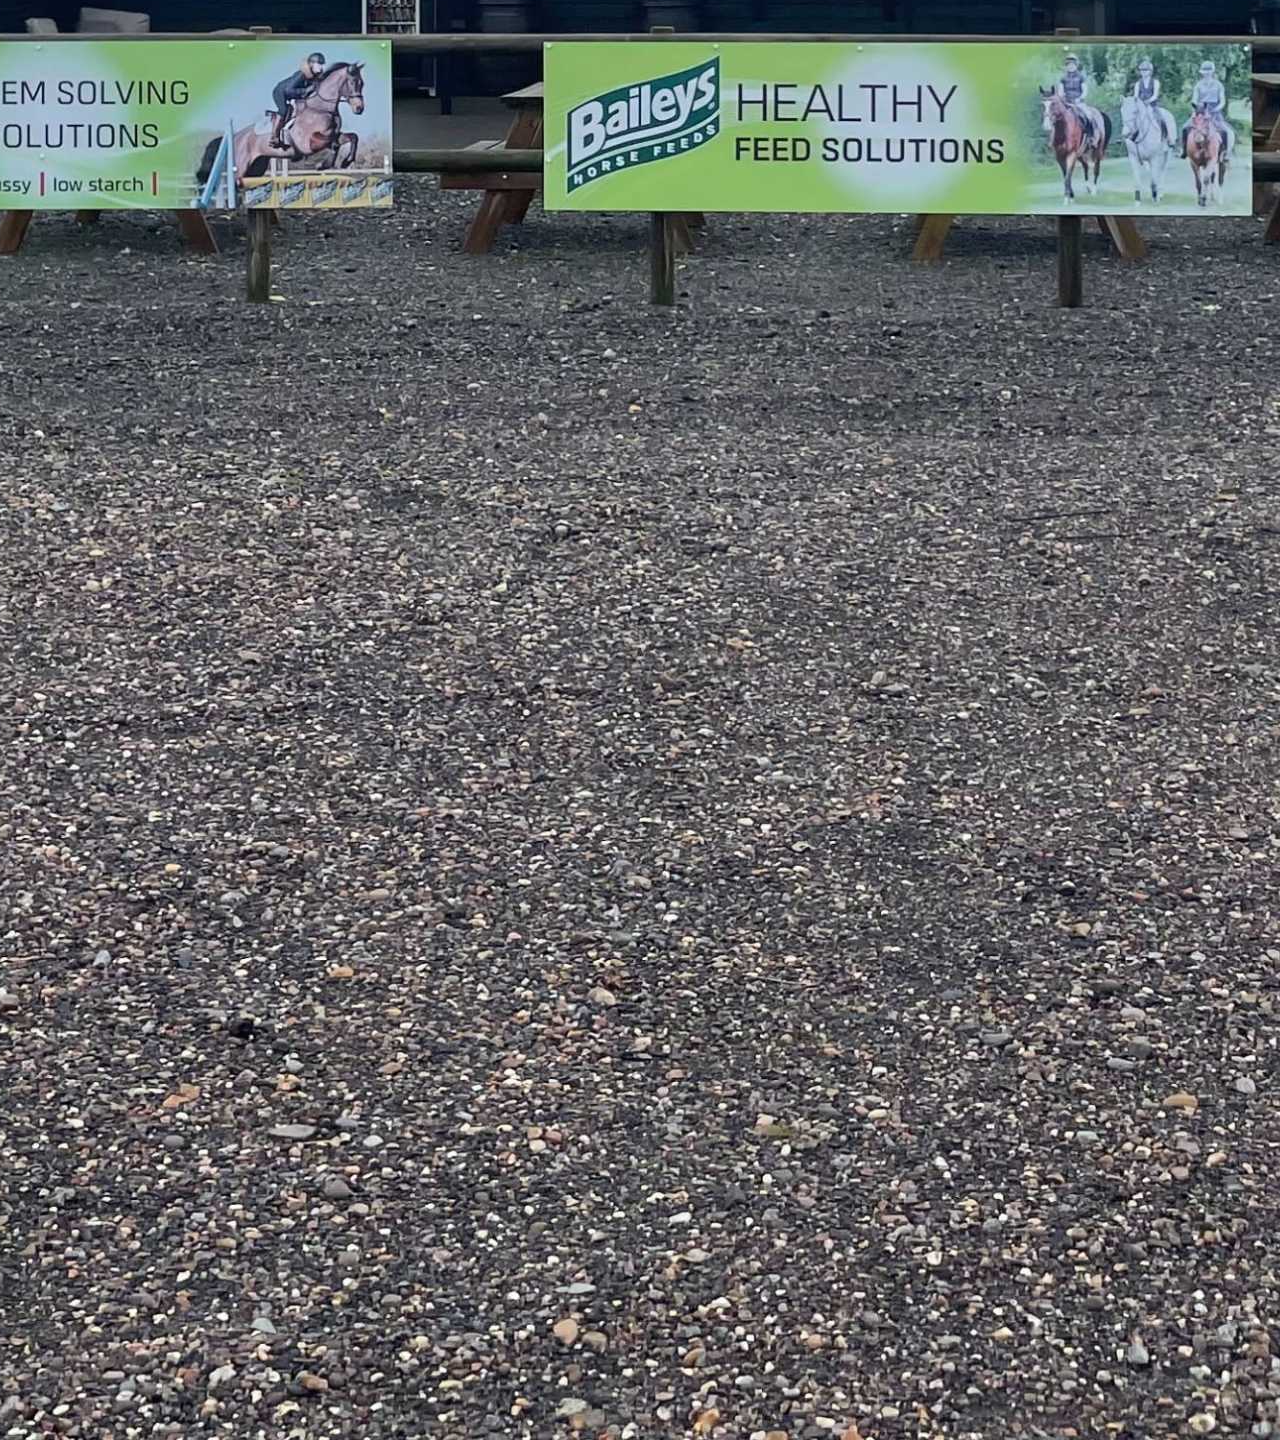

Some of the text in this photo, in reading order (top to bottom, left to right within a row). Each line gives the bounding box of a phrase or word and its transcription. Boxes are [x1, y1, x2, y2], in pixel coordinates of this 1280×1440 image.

[57, 80, 189, 105] SOLVING
[737, 83, 958, 123] HEALTHY
[571, 67, 716, 165] Baileys
[574, 124, 716, 184] HORSE FEEDS
[735, 137, 1005, 164] FEED SOLUTIONS
[53, 177, 83, 192] low
[88, 176, 144, 192] starch
